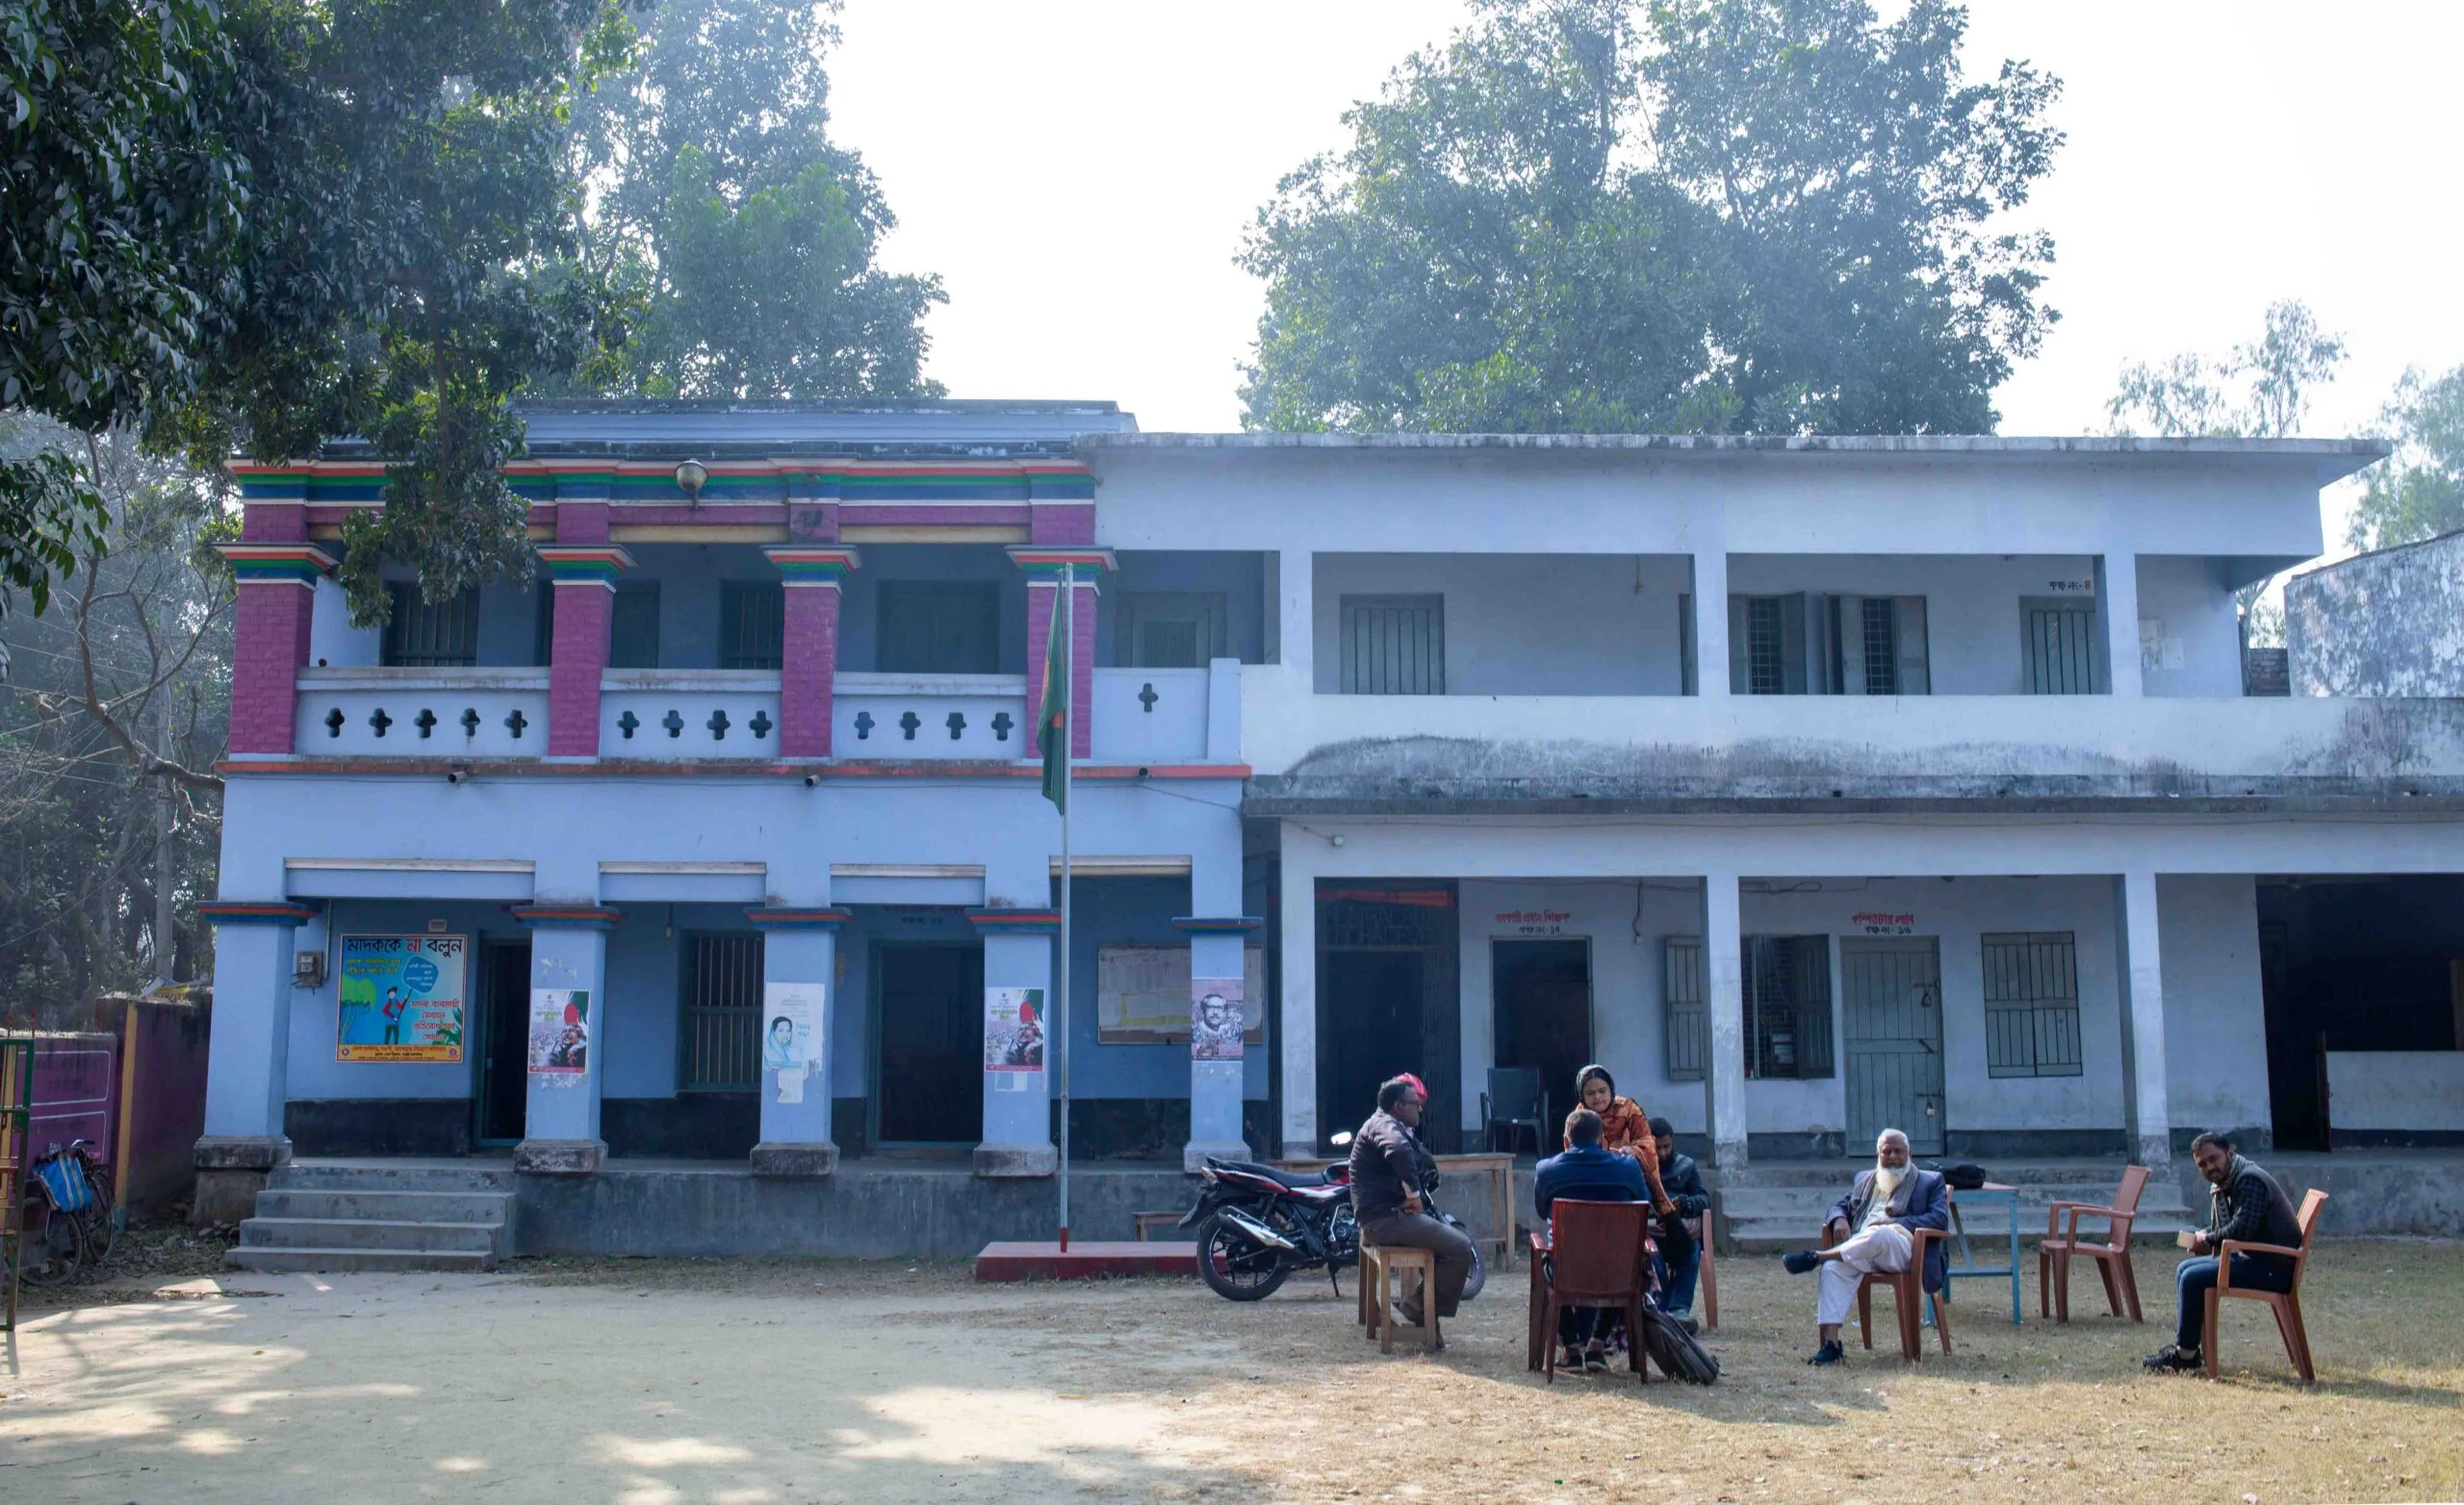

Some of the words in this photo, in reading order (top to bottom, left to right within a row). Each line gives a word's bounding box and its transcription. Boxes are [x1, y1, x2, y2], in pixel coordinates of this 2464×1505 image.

[346, 938, 402, 954] মাদককে
[405, 938, 422, 954] না
[426, 938, 462, 957] বলুন
